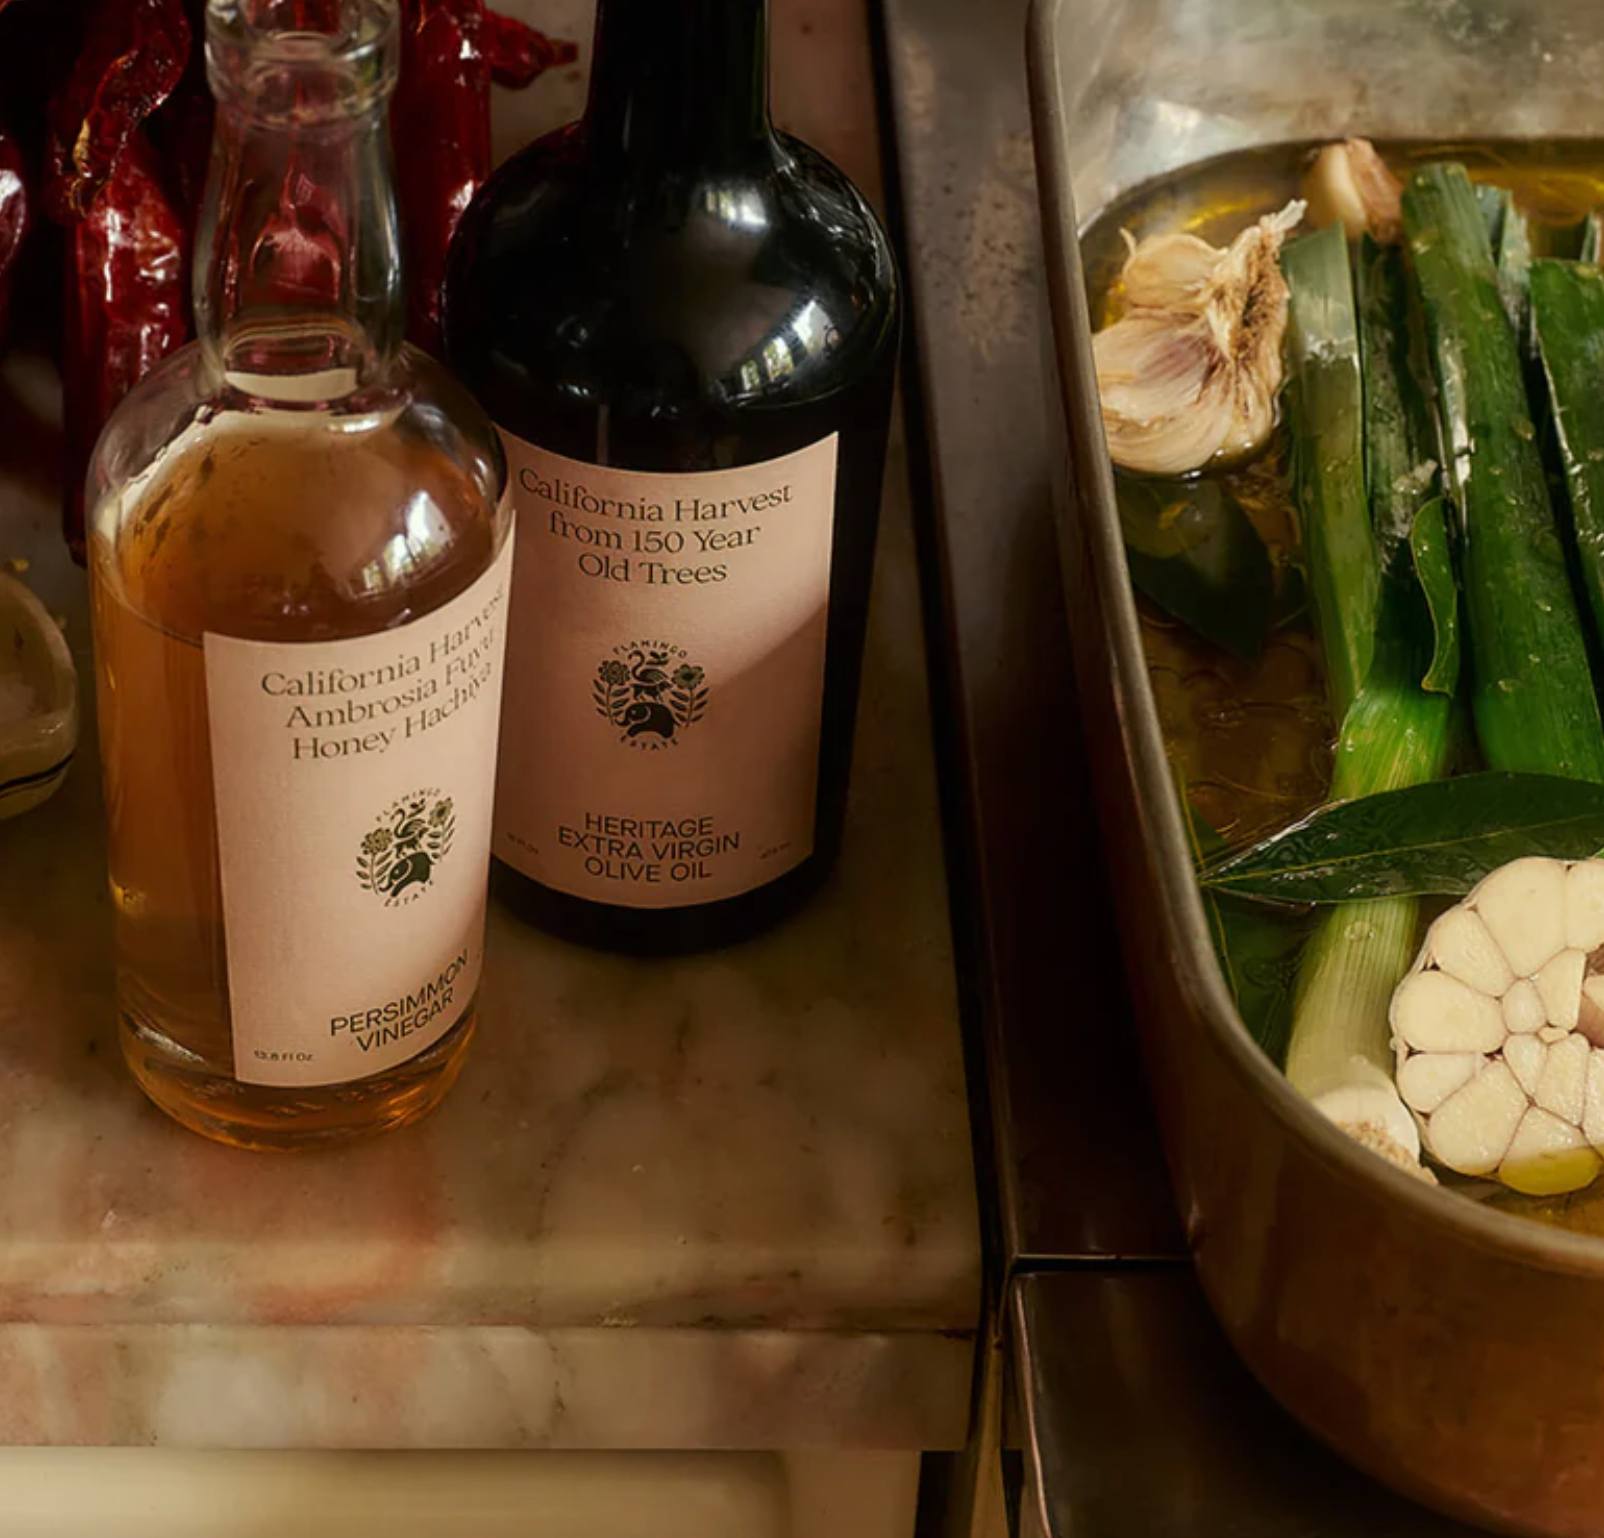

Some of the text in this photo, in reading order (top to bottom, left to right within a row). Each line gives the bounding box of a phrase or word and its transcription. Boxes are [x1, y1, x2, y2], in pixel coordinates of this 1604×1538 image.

[519, 468, 793, 522] California Harvest
[549, 511, 761, 553] from 150 Year
[578, 553, 727, 584] Old Trees
[613, 640, 687, 659] FLAMINGO
[262, 654, 420, 697] California
[286, 679, 437, 728] Ambrosia
[292, 662, 491, 760] Honey Hachiya
[558, 825, 643, 860] EXTRA
[652, 831, 740, 861] VIRGIN
[585, 812, 714, 839] HERITAGE
[584, 856, 713, 883] OLIVE OIL
[330, 948, 468, 1037] PERSIMMON
[355, 987, 454, 1052] VINEGAR
